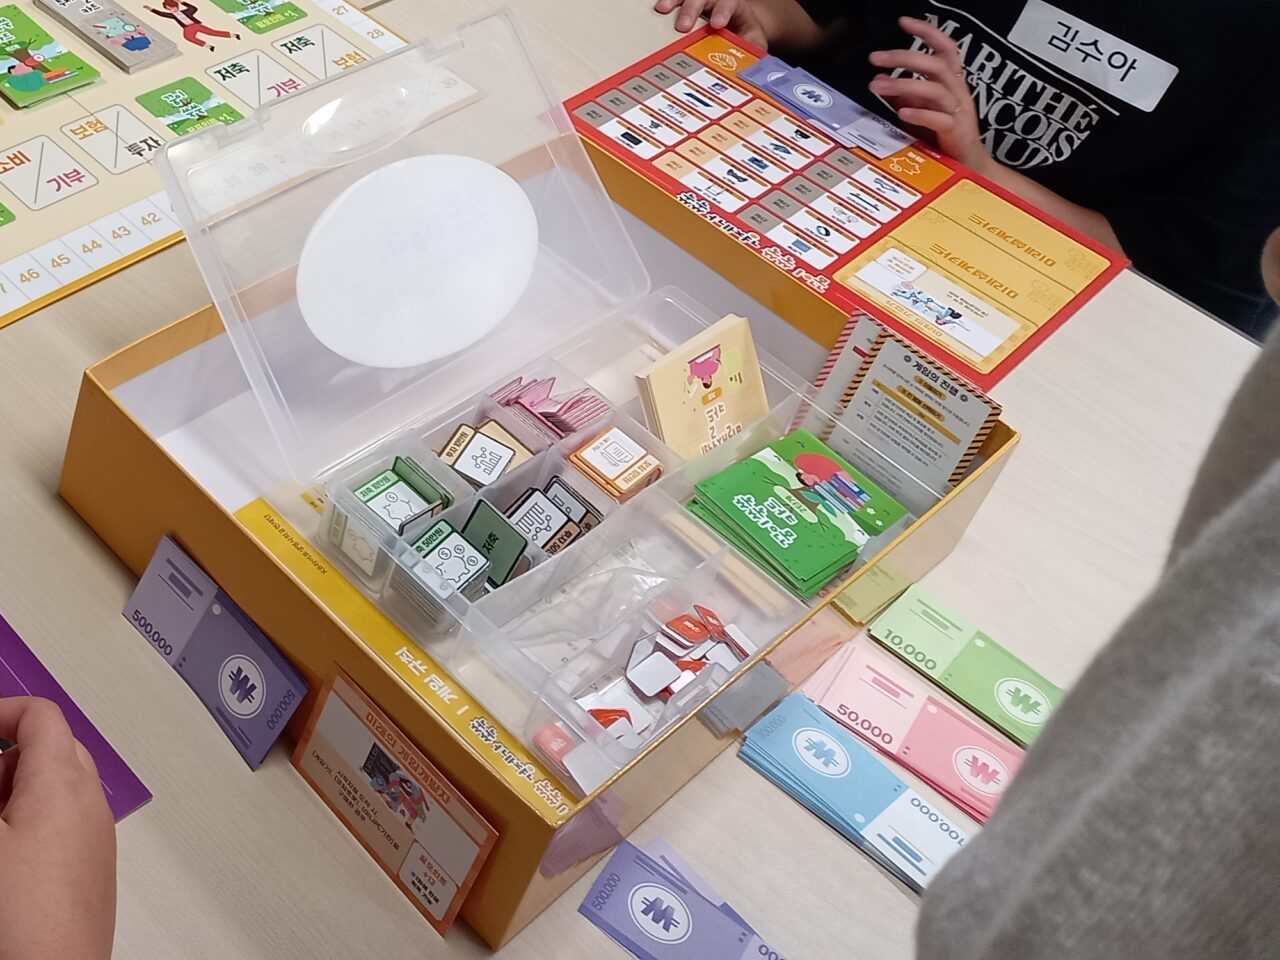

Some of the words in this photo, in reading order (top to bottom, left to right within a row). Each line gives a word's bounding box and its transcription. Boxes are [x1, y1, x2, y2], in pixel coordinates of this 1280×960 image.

[79, 3, 103, 15] 카드
[332, 5, 350, 16] 27
[280, 34, 316, 55] 저축
[367, 28, 384, 40] 28
[332, 50, 368, 70] 보험
[1047, 20, 1138, 82] 김수아
[214, 61, 251, 82] 저축
[266, 77, 302, 99] 기부
[69, 118, 110, 140] 보험
[124, 135, 162, 158] 투자
[46, 168, 87, 192] 기부
[140, 212, 162, 228] 42
[111, 226, 132, 241] 43
[968, 213, 1056, 268] 미래설계카드
[81, 239, 103, 256] 44
[50, 252, 72, 270] 45
[928, 243, 1019, 299] 미래설계카드
[19, 268, 41, 285] 46
[792, 269, 831, 294] 꿈이
[912, 360, 940, 382] 게임의
[940, 381, 960, 398] 진행
[706, 404, 725, 423] 카드
[732, 494, 798, 548] 꿈이쑥쑥
[763, 497, 798, 526] 카드
[480, 532, 500, 554] 저축
[131, 609, 174, 656] 500,000
[395, 646, 428, 676] 규칙
[883, 628, 938, 672] 10,000
[424, 673, 458, 704] 게임
[266, 688, 296, 730] 500,000
[836, 703, 894, 746] 50,000
[492, 740, 536, 784] 경제가
[591, 872, 621, 912] 500,000
